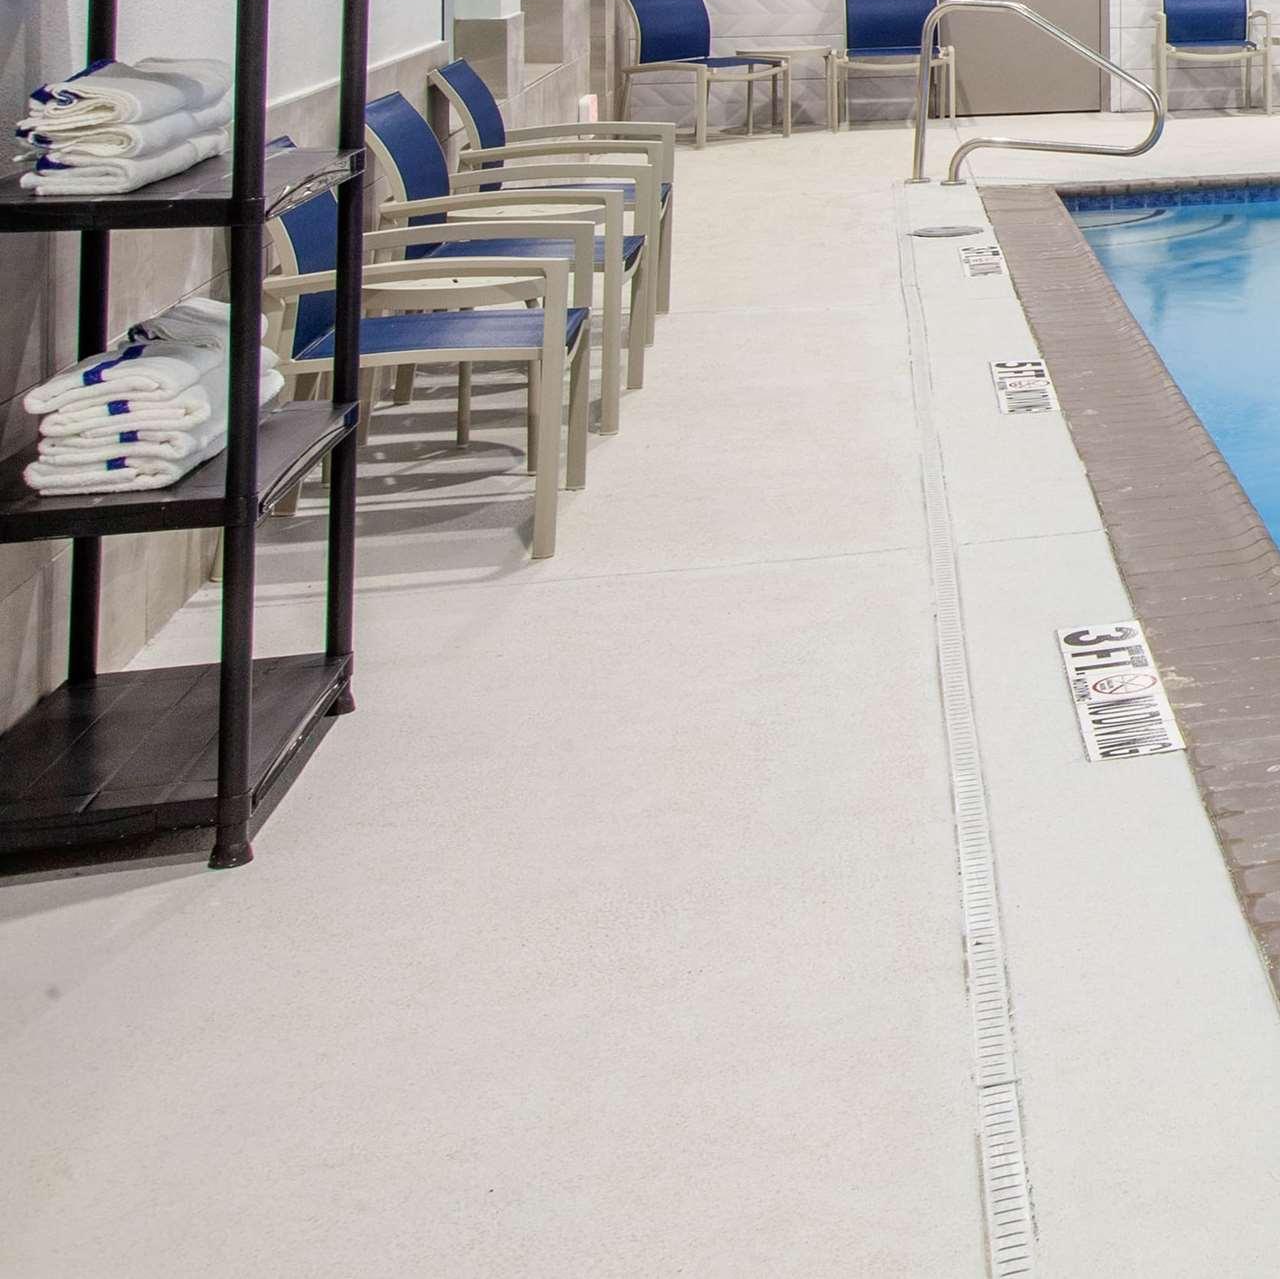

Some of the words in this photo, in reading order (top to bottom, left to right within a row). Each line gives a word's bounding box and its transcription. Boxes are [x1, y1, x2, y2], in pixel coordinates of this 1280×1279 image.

[1063, 626, 1139, 646] 3
[1086, 694, 1159, 715] NO
[1091, 710, 1173, 759] DIVING
